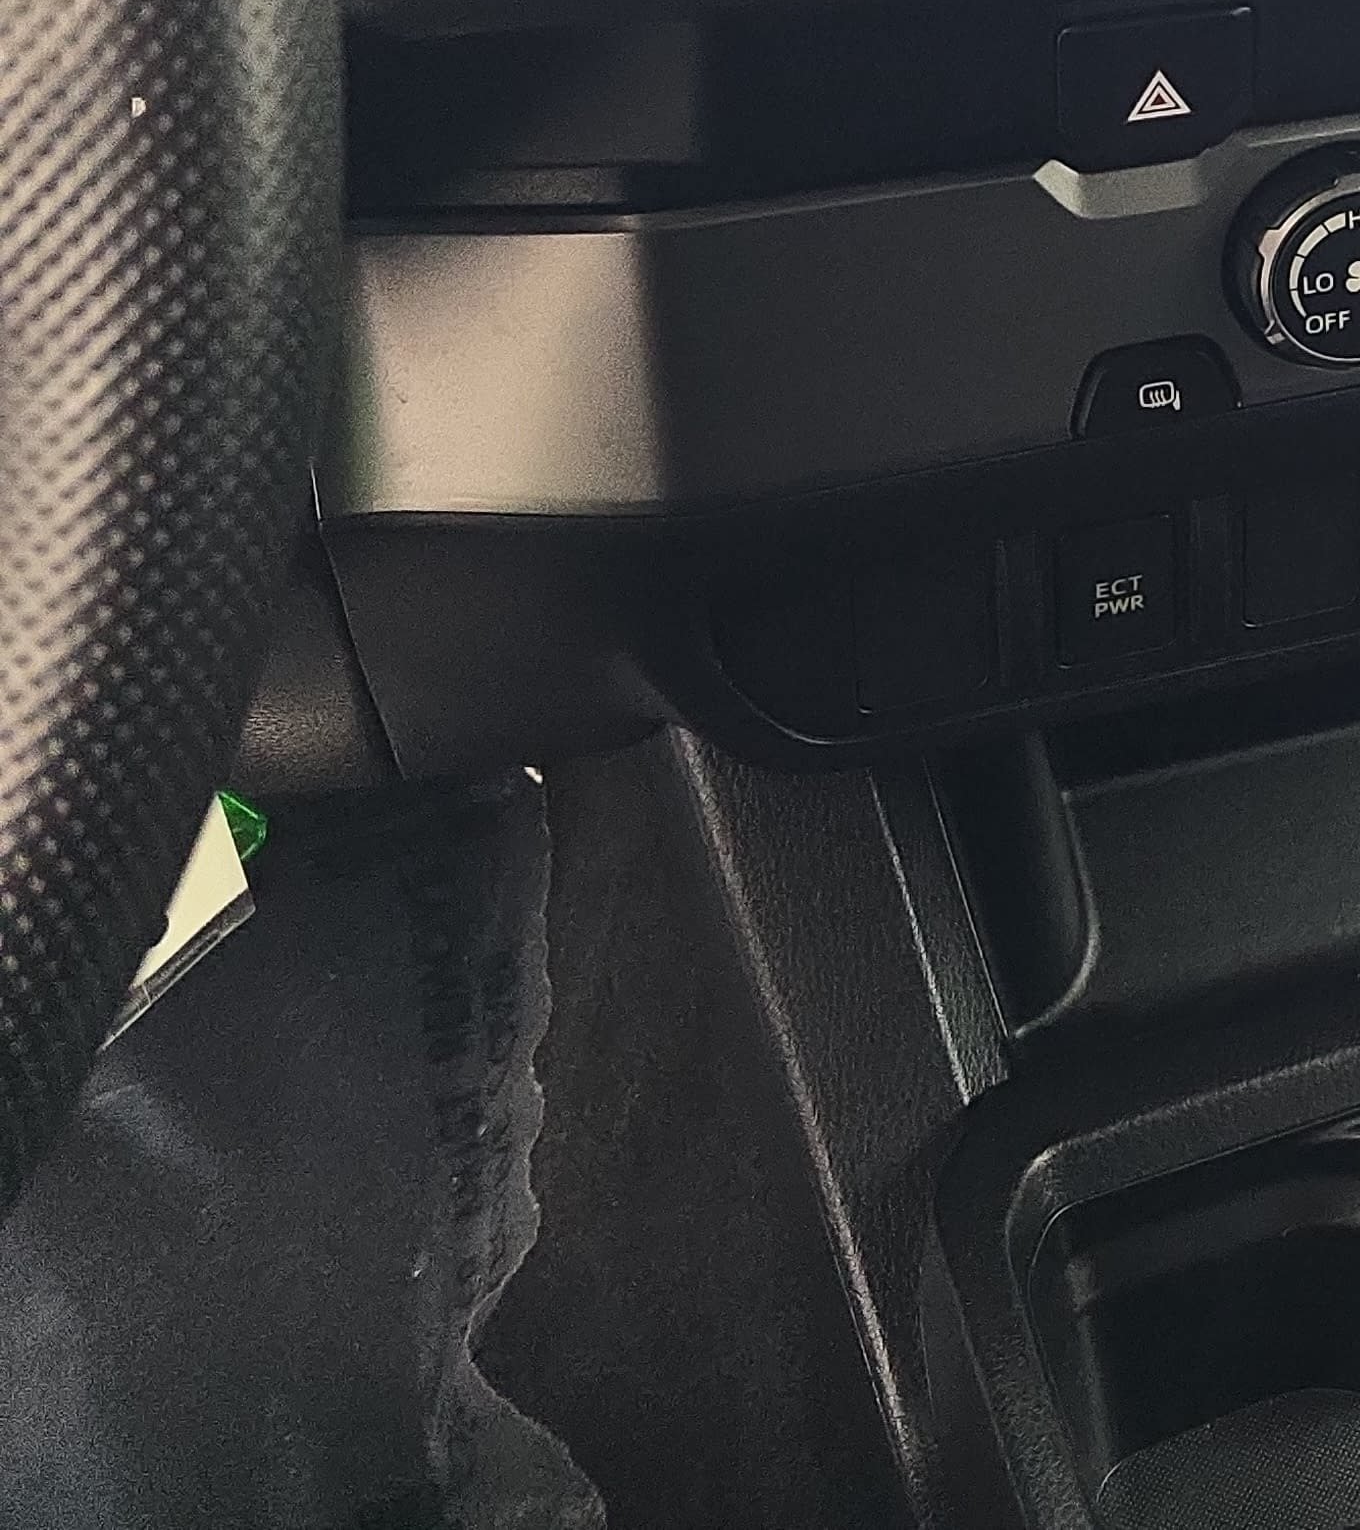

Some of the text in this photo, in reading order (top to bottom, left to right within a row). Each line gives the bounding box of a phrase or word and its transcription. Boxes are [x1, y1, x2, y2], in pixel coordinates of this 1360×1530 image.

[1303, 272, 1334, 294] LO
[1305, 310, 1351, 334] OFF
[1095, 575, 1143, 598] ECT
[1094, 595, 1144, 618] PWR
